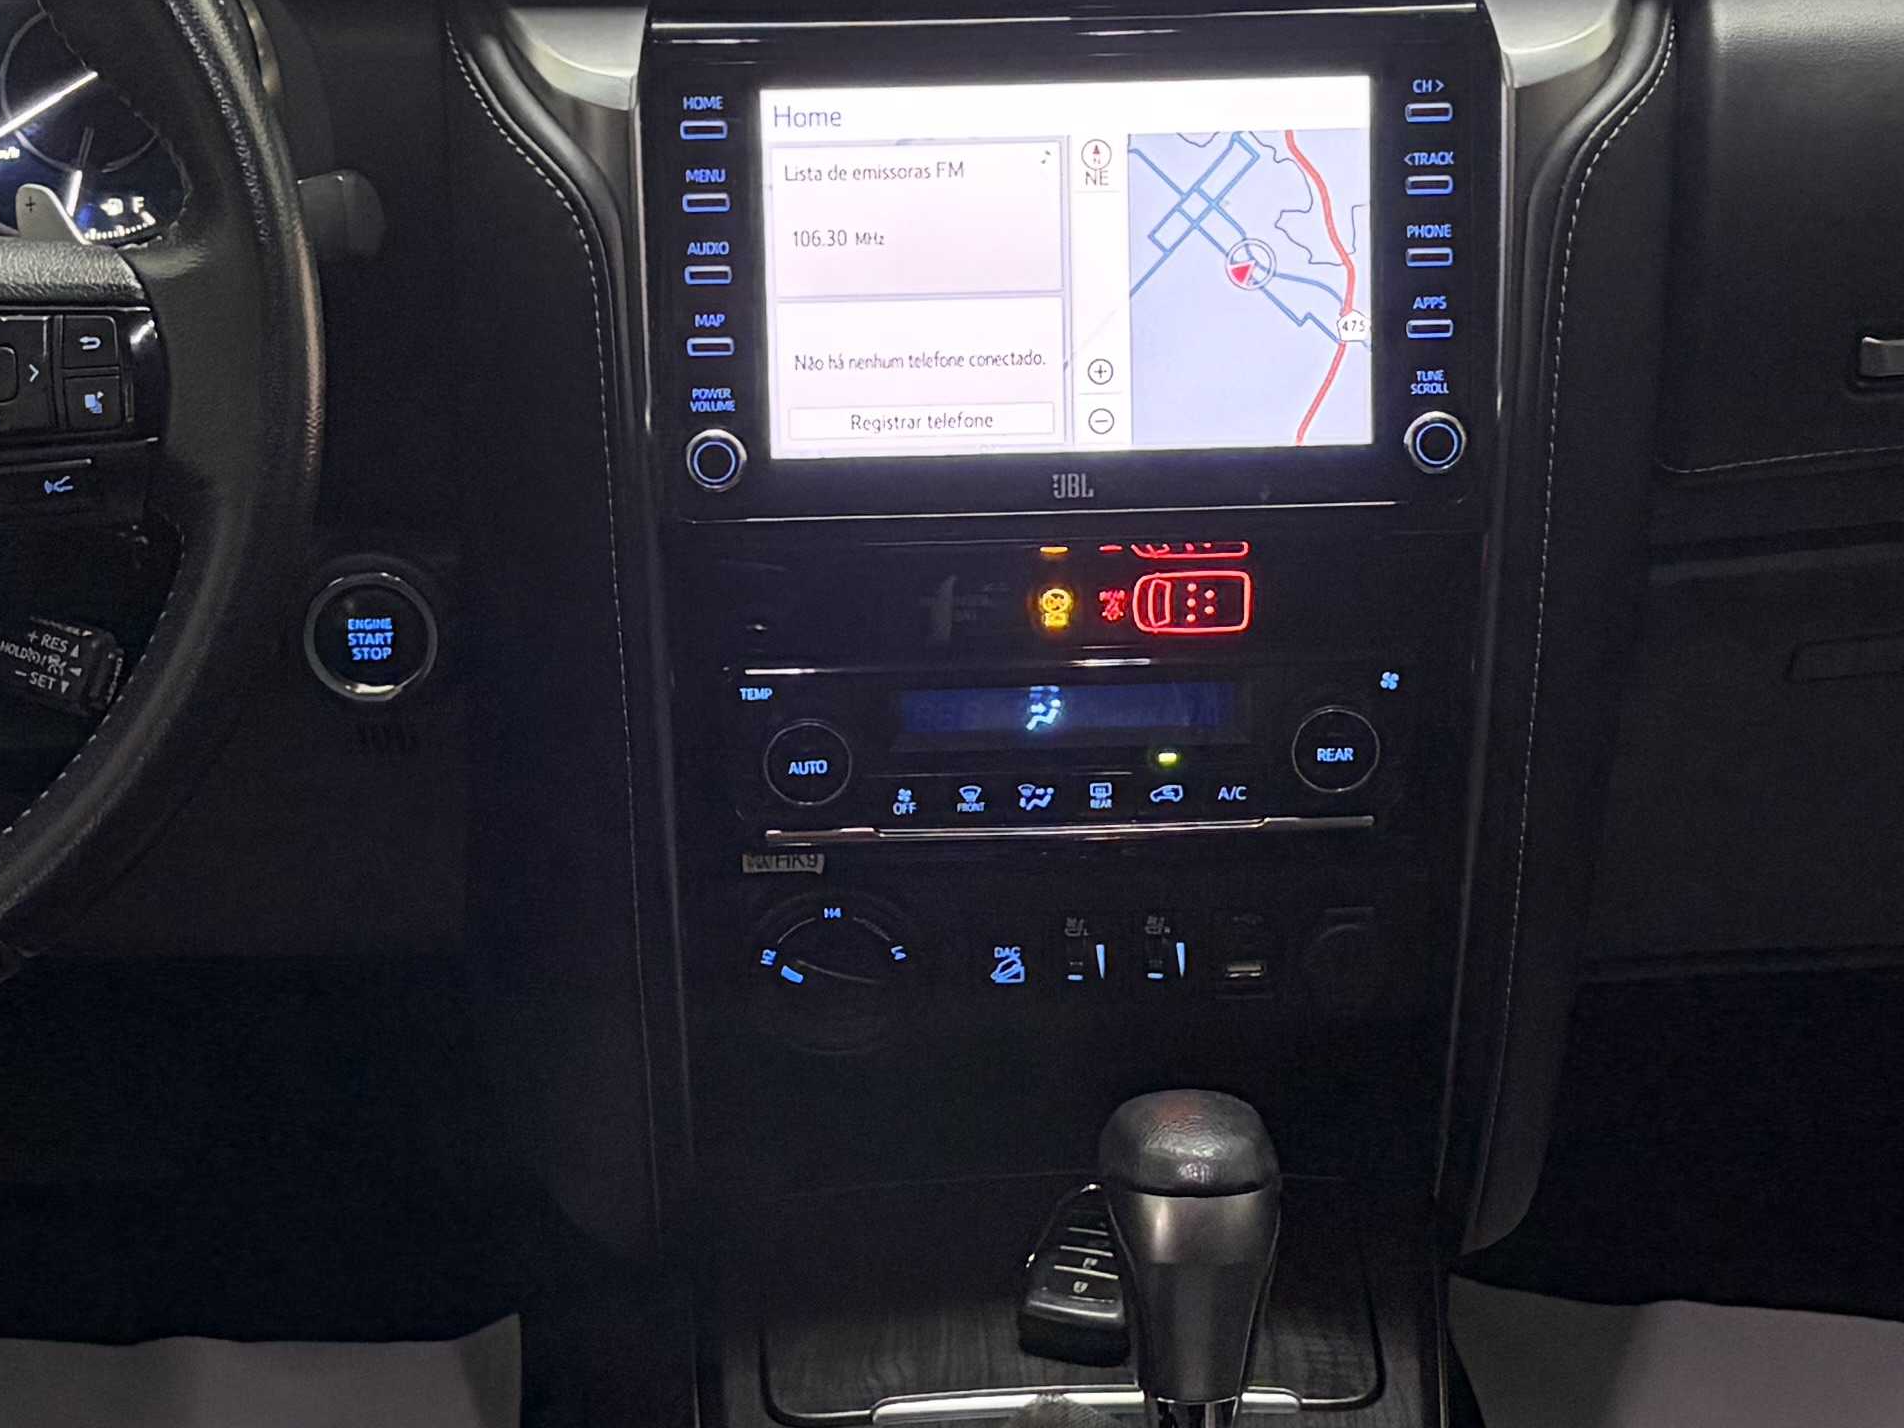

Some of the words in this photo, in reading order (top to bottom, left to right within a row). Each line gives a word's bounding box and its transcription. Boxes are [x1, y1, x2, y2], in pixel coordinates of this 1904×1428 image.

[683, 96, 723, 111] HOME
[774, 106, 842, 128] Home
[686, 169, 726, 183] MENU
[784, 165, 822, 182] Lista
[827, 164, 847, 181] de
[852, 163, 931, 180] emissoras
[936, 161, 965, 179] FM
[1084, 171, 1109, 186] NE
[132, 196, 145, 213] F
[792, 230, 848, 248] 106.30
[855, 233, 885, 247] MHz
[1407, 224, 1452, 239] PHONE
[687, 241, 729, 256] AUDIO
[1413, 296, 1447, 311] APPS
[695, 314, 725, 328] MAP
[1341, 319, 1366, 333] 475
[794, 353, 824, 371] Não
[828, 353, 844, 370] há
[849, 353, 904, 370] nenhum
[908, 352, 965, 368] telefone
[969, 350, 1046, 368] conectado.
[1416, 370, 1445, 382] TUNE
[692, 388, 732, 400] POWER
[1410, 382, 1449, 395] SCROLL
[690, 401, 736, 413] VOLUME
[850, 414, 922, 434] Registrar
[927, 412, 994, 429] telefone
[1052, 473, 1094, 499] JBL
[347, 617, 393, 631] ENGINE
[41, 633, 69, 653] RES
[348, 632, 394, 646] START
[352, 646, 393, 661] STOP
[29, 671, 57, 691] SET
[740, 686, 773, 702] TEMP
[1316, 746, 1354, 762] REAR
[788, 758, 828, 776] AUTO
[1218, 785, 1247, 801] A/C
[893, 802, 917, 816] OFF
[957, 801, 985, 813] FRONT
[1089, 798, 1112, 810] REAR
[760, 948, 777, 965] H2
[994, 947, 1021, 958] DAC
